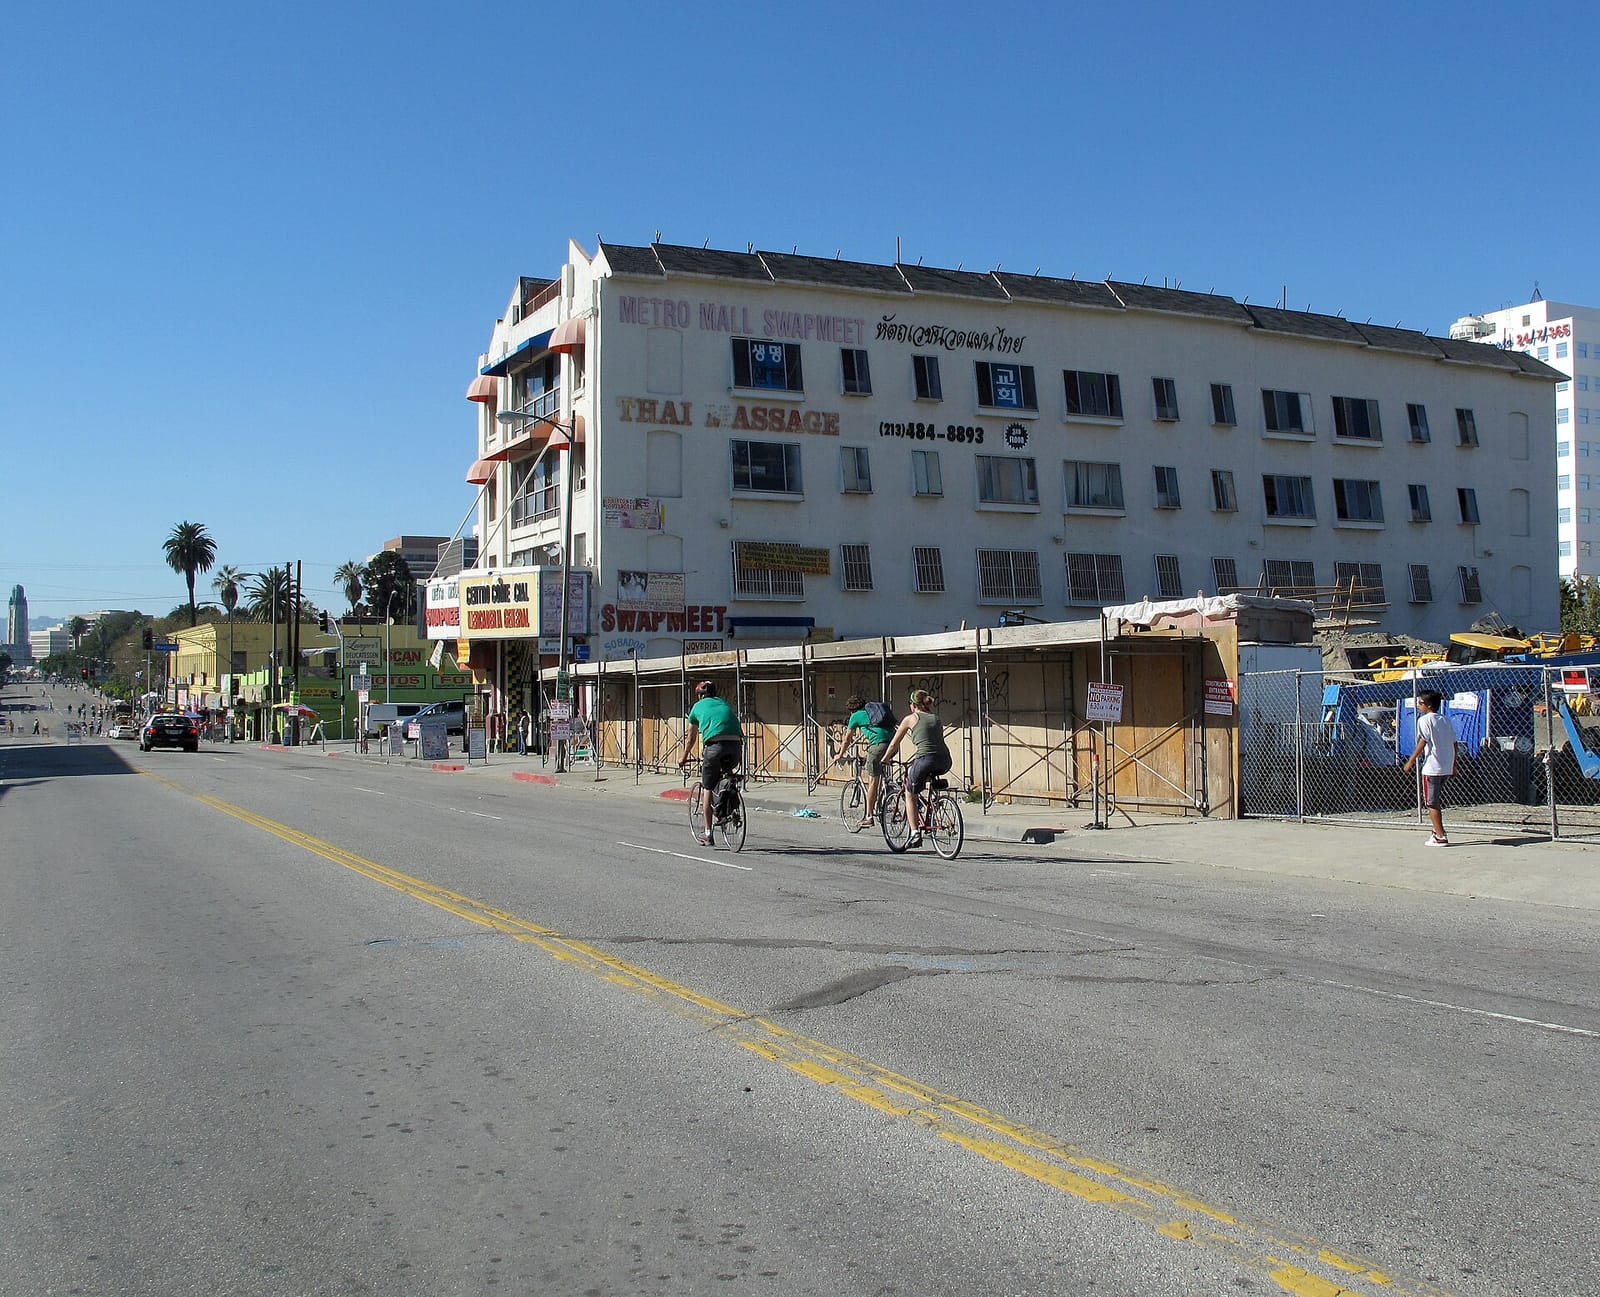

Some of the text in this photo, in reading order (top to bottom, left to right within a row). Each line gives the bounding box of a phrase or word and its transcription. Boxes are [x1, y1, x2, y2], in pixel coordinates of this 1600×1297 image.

[619, 295, 866, 345] METRO MALL SWAPMEET
[995, 368, 1017, 406] 교회
[617, 396, 693, 426] THAI
[879, 421, 985, 444] (213)484-8893
[601, 603, 727, 633] SWAPMEET
[603, 637, 646, 653] SOBADOR
[1089, 693, 1121, 704] NO PARKING
